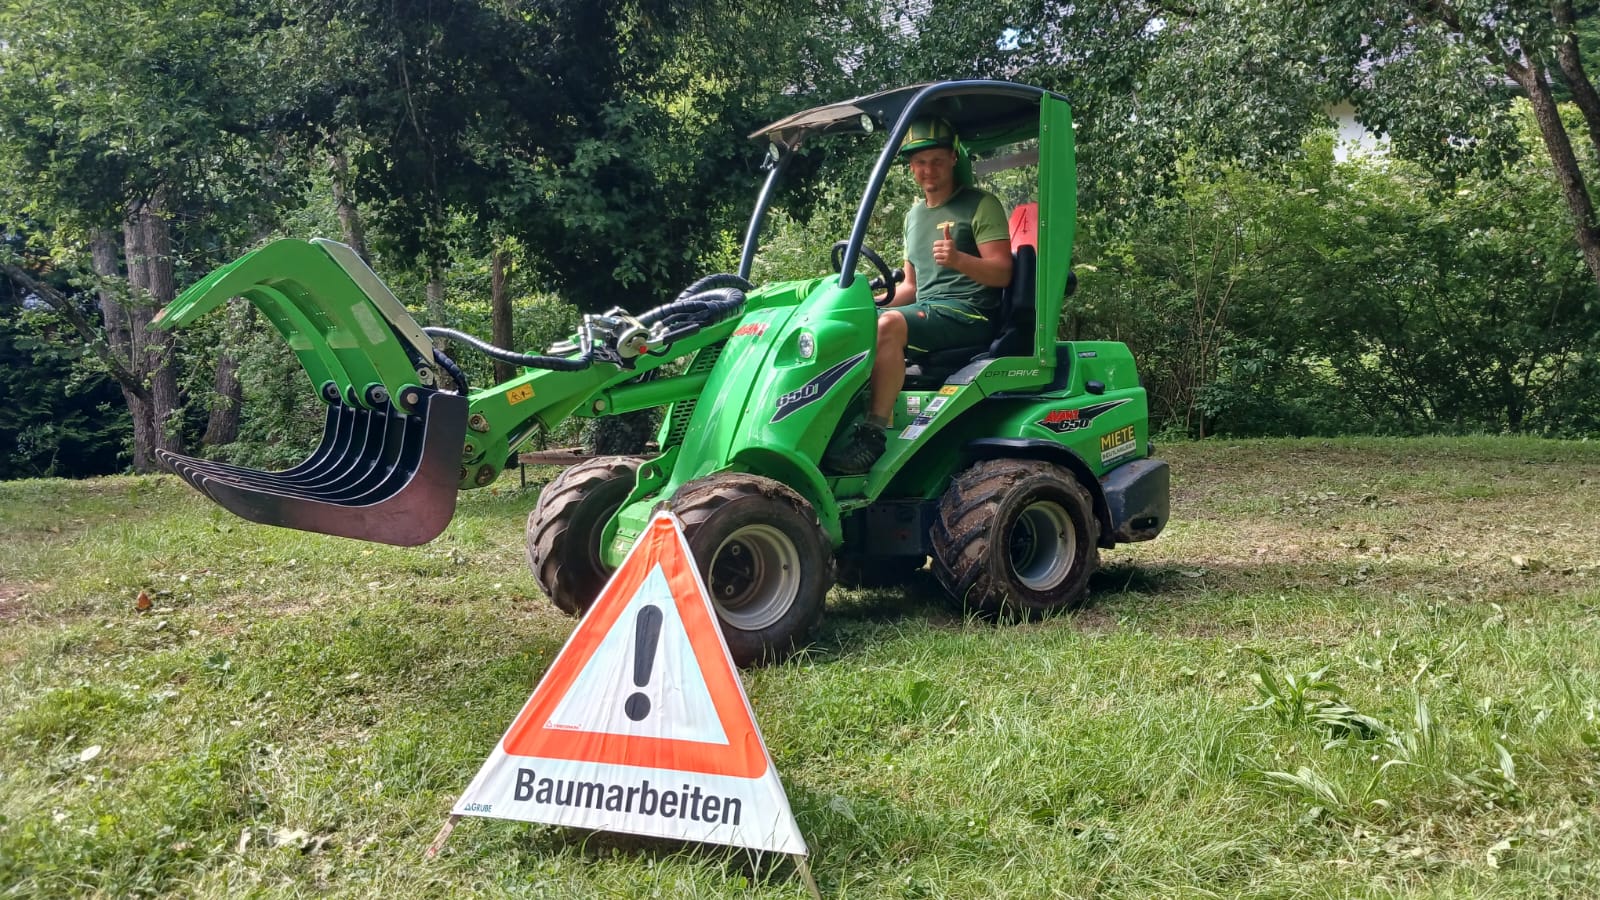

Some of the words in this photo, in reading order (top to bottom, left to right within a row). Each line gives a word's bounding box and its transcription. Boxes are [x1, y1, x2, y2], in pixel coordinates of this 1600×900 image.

[985, 369, 1040, 377] OPTIDRIVE
[1043, 409, 1079, 424] AVANT
[1101, 425, 1135, 451] MIETE
[513, 767, 742, 826] Baumarbeiten
[471, 802, 493, 813] GRUBE
